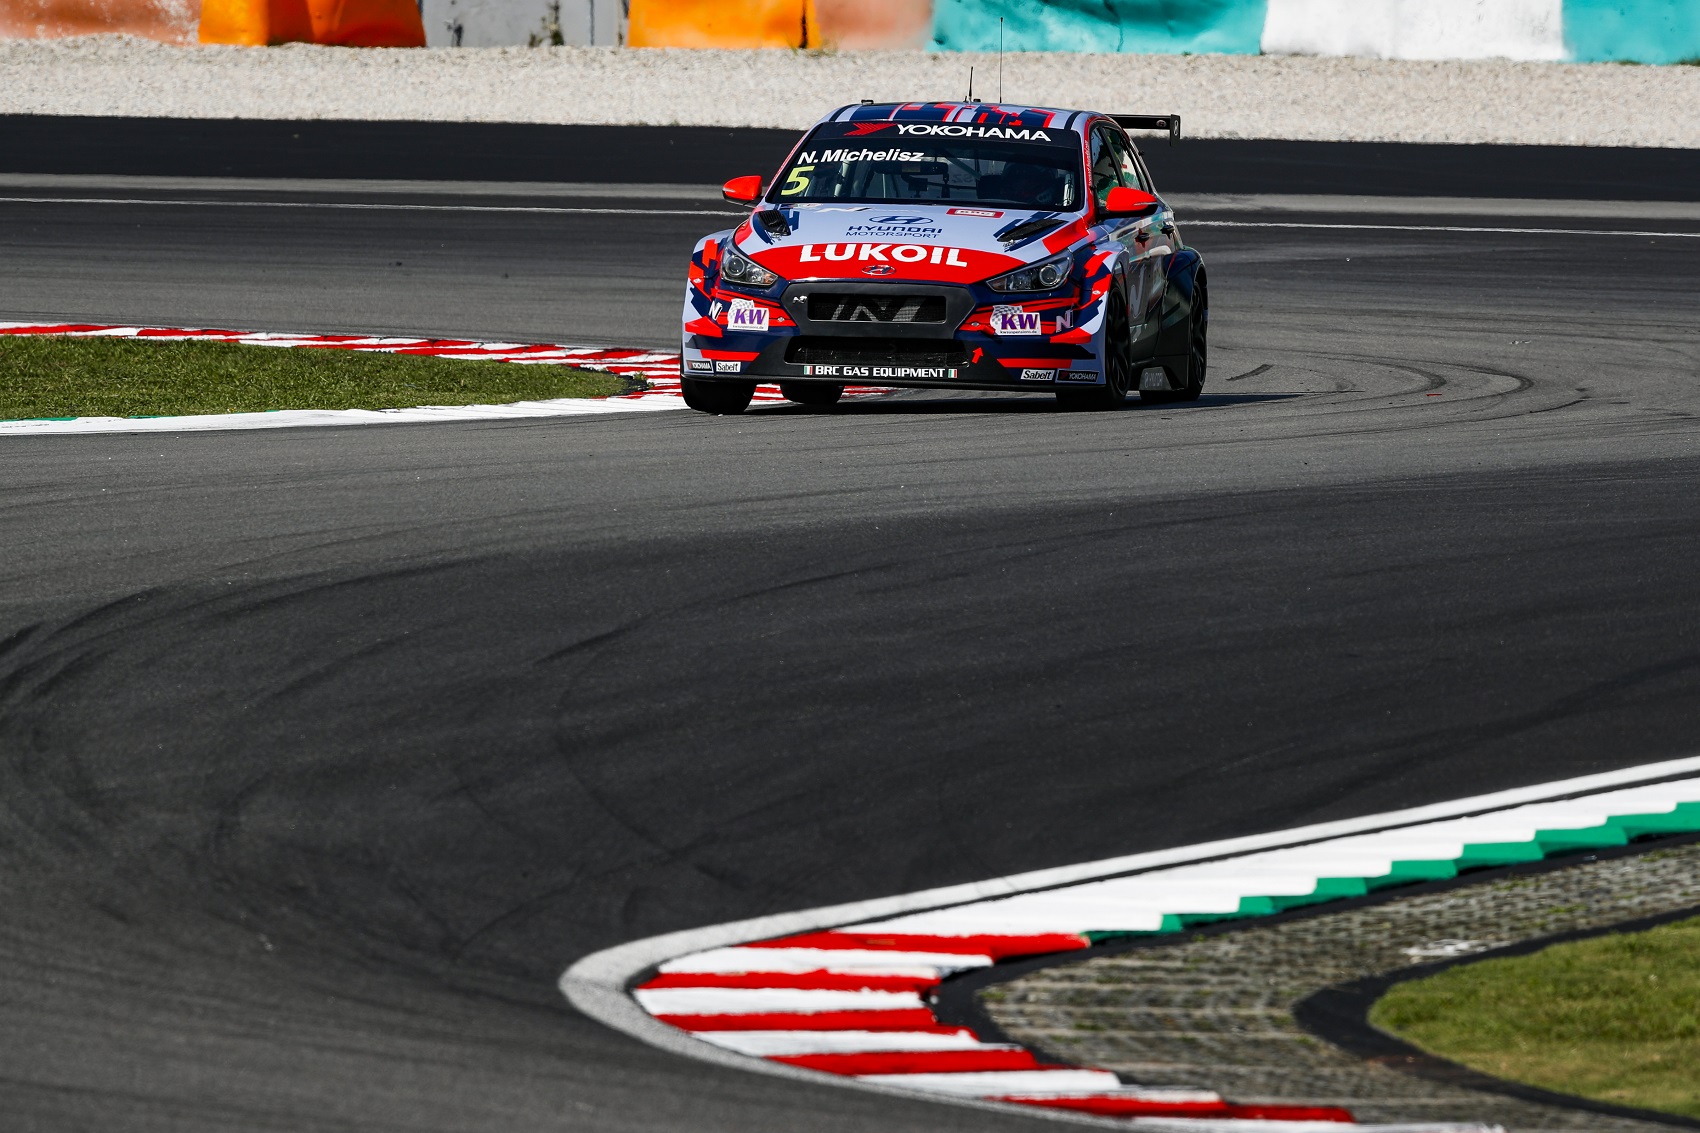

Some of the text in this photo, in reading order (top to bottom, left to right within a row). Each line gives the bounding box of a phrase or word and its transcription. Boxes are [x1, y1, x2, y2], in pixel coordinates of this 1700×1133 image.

[896, 123, 1051, 142] YOKOHAMA
[797, 148, 925, 165] N. Michelisz
[780, 165, 815, 196] 5
[845, 231, 940, 239] MOTORSPORT
[847, 225, 943, 234] HYUNDAI
[799, 243, 968, 268] LUKOIL
[733, 308, 768, 325] KW
[1001, 313, 1039, 330] KW
[815, 365, 946, 378] BRC GAS EQUIPMENT
[1023, 369, 1053, 380] Sabelt
[1068, 372, 1097, 380] YOKOHAMA
